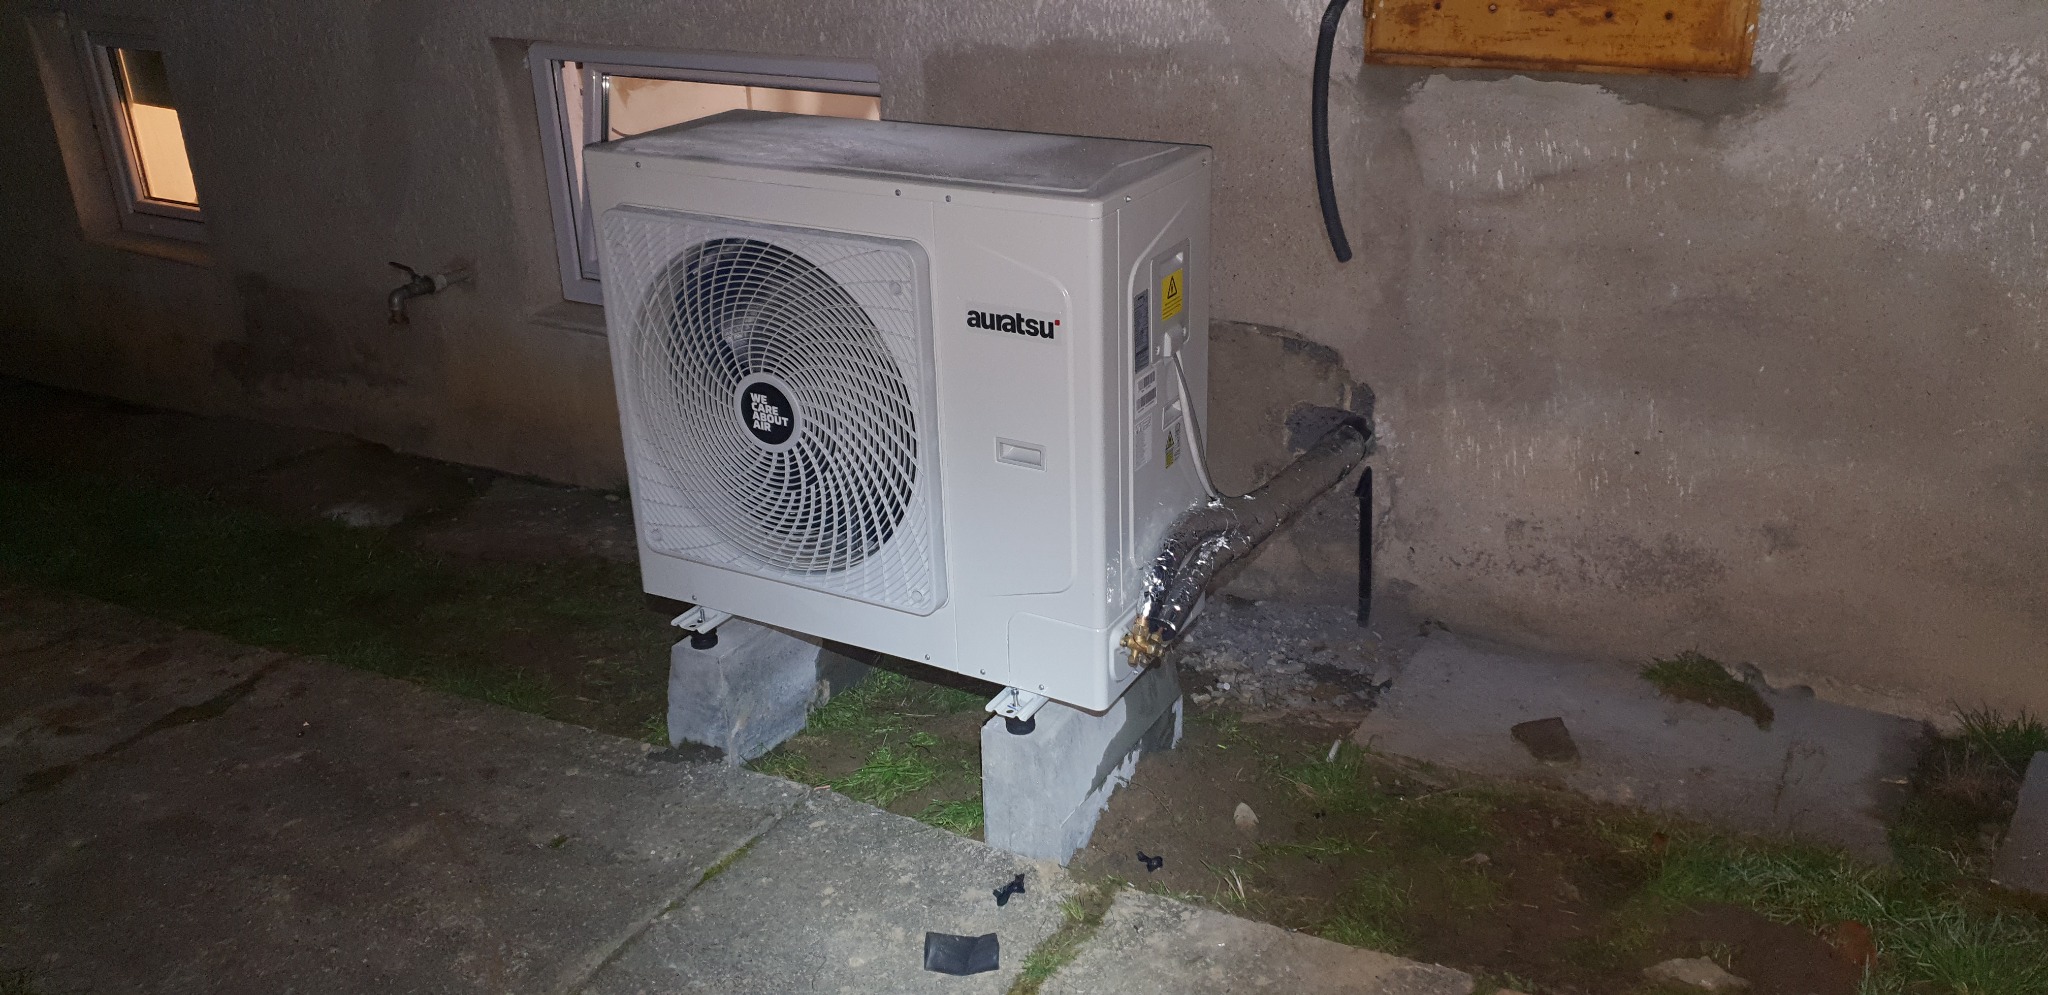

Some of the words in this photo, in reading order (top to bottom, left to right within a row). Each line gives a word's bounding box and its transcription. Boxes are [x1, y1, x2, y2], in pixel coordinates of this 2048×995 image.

[967, 310, 1054, 339] auratsu
[750, 393, 768, 405] WE
[751, 402, 779, 416] CARE
[752, 411, 789, 427] ABOUT
[753, 420, 771, 432] AIR
